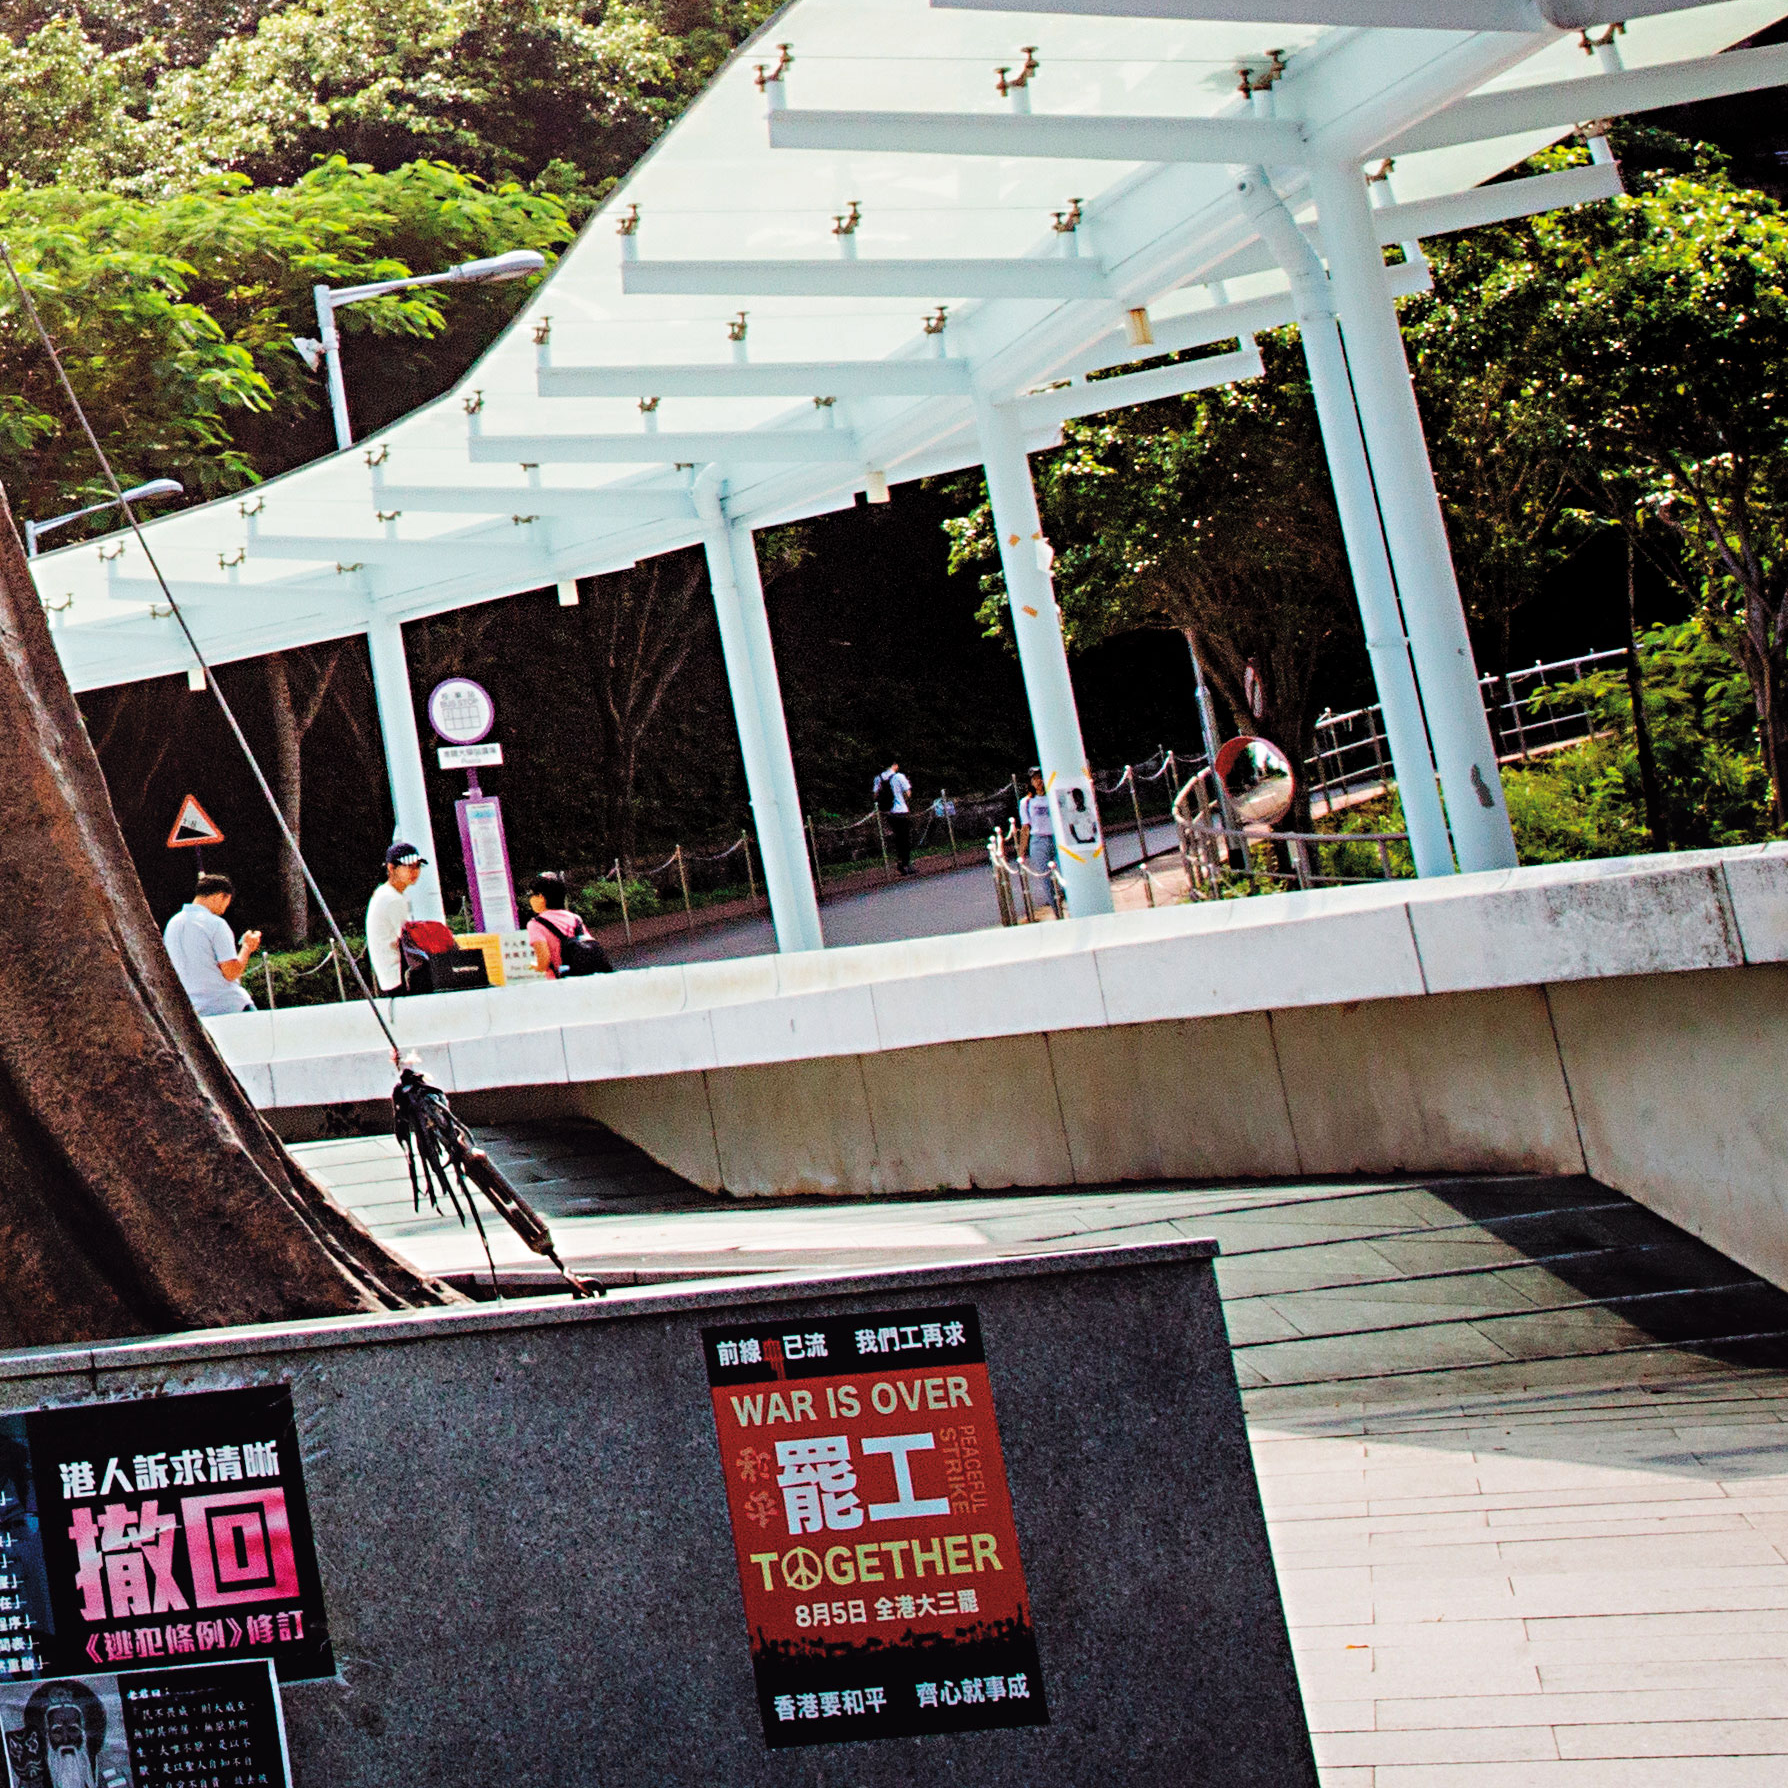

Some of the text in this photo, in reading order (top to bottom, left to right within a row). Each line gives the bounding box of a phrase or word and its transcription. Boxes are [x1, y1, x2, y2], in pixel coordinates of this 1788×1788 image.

[854, 1321, 966, 1354] 我們工再求
[730, 1376, 973, 1427] WAR IS OVER
[59, 1440, 280, 1499] 港人訴求清晰
[774, 1432, 952, 1535] 罷工
[939, 1427, 970, 1516] STRIKE
[958, 1425, 989, 1513] PEACEFUL
[68, 1487, 300, 1622] 撤回
[795, 1589, 979, 1627] 8月5日 全港大三罷
[774, 1673, 1030, 1721] 香港要和平 齊心就事成
